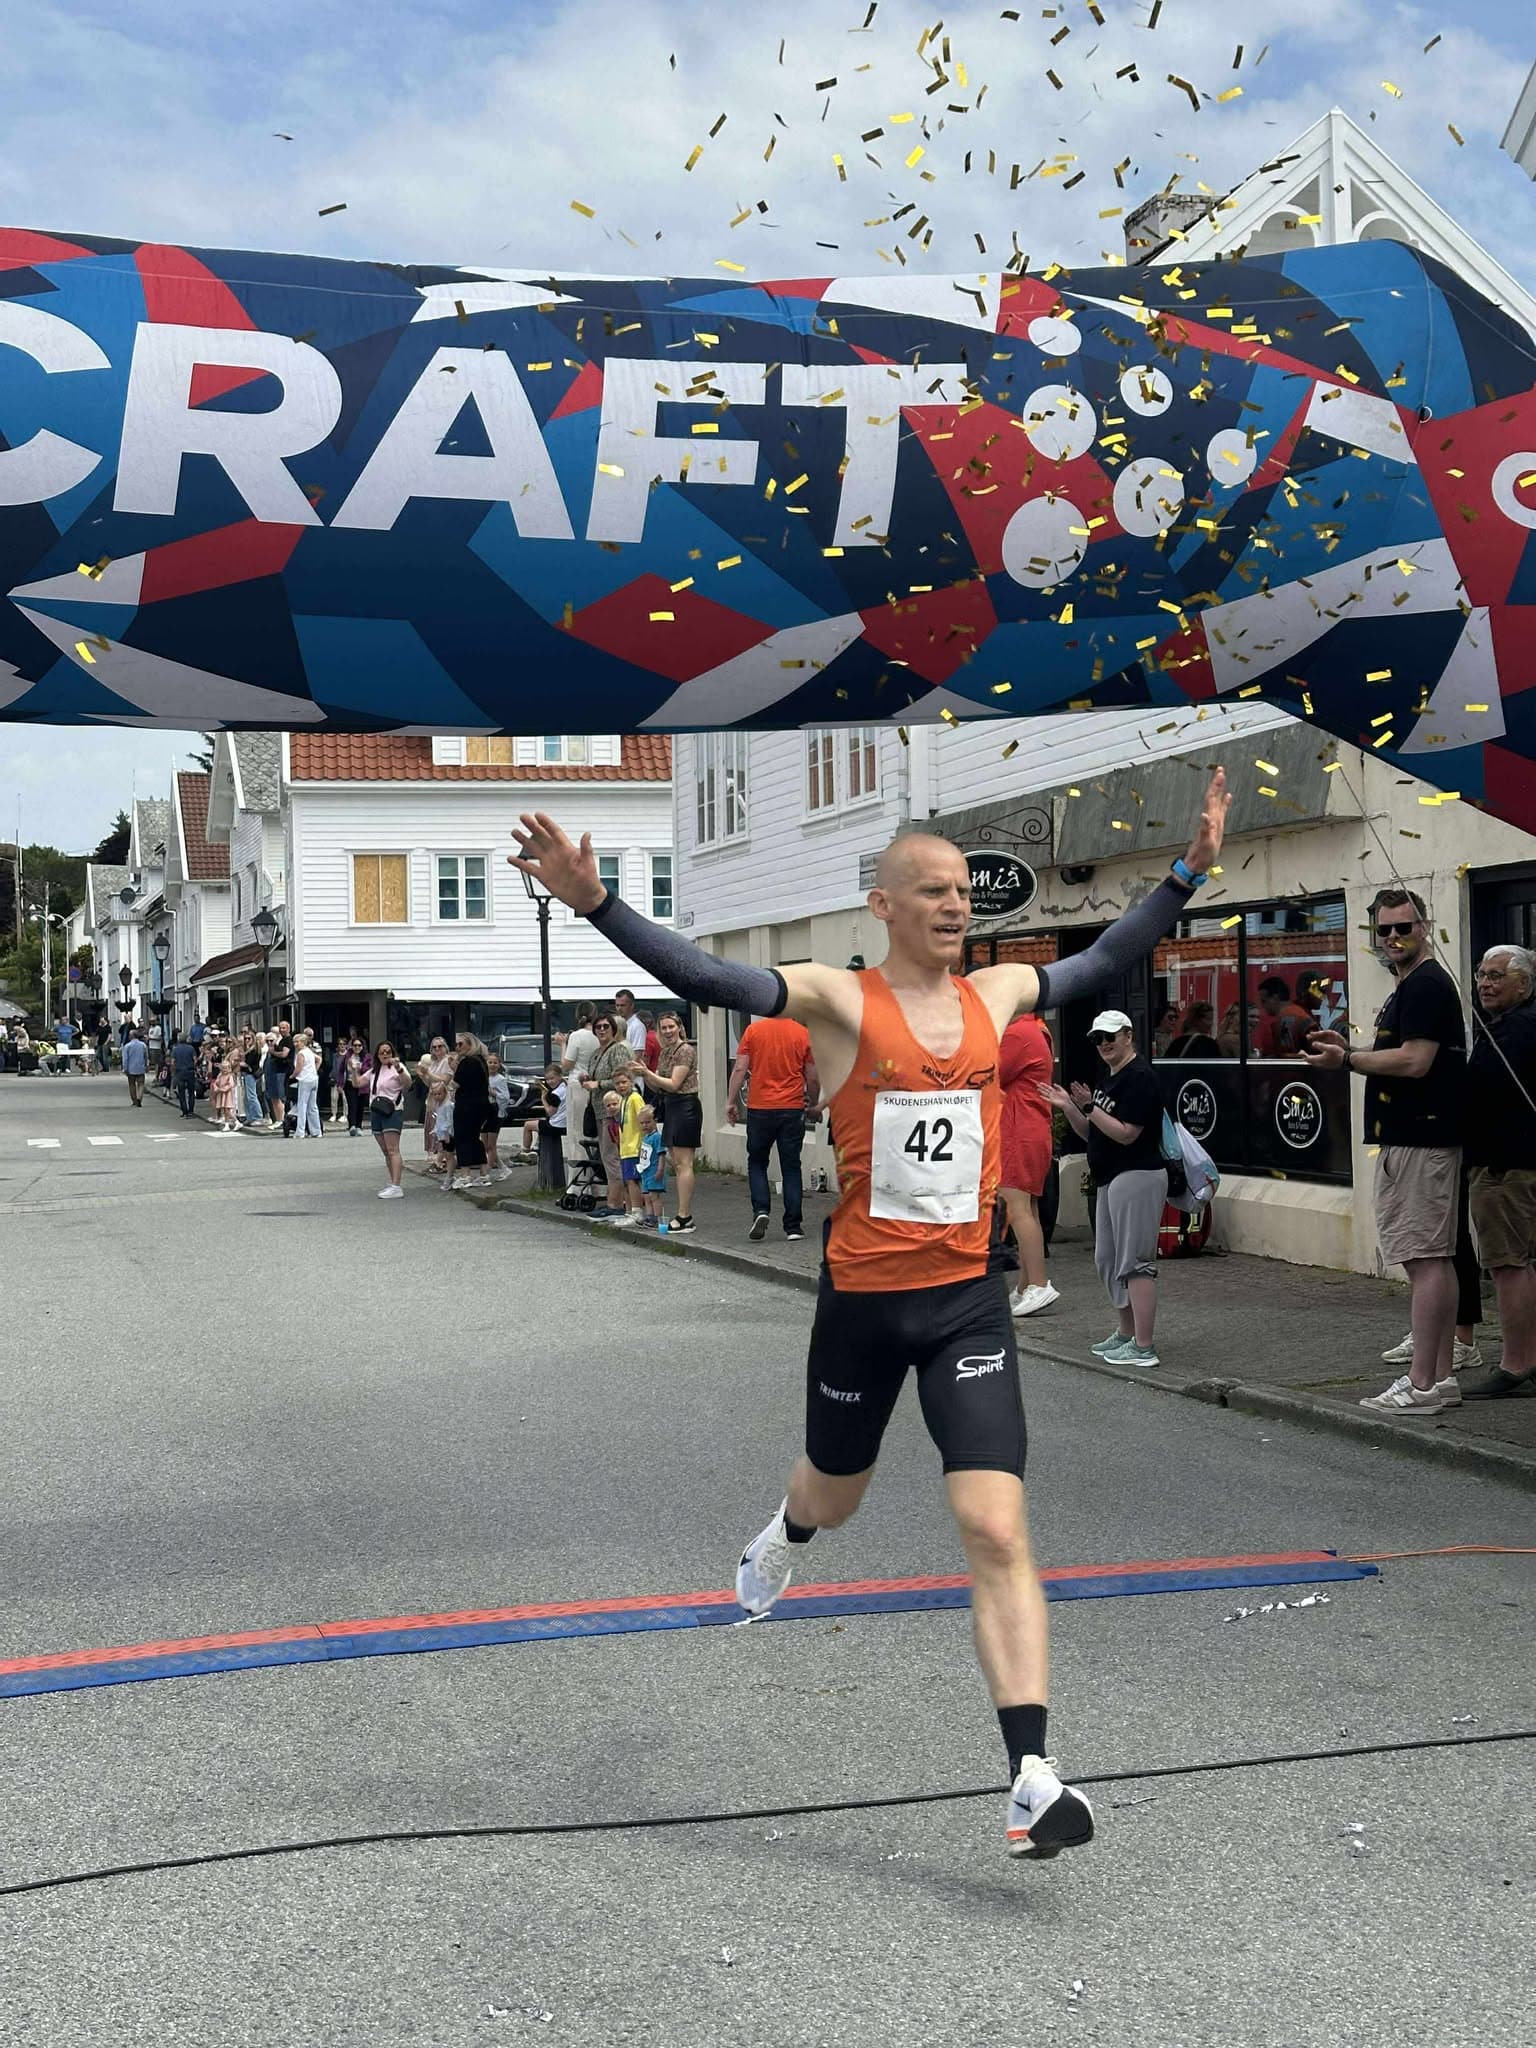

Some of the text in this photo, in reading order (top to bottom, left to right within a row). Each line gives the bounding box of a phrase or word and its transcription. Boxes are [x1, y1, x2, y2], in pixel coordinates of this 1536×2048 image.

[971, 863, 1021, 891] miå
[883, 1095, 973, 1107] SKUDENESHAVNLØPET
[904, 1117, 953, 1162] 42
[956, 1347, 1006, 1382] Spirit
[819, 1381, 862, 1402] TRIMTEX
